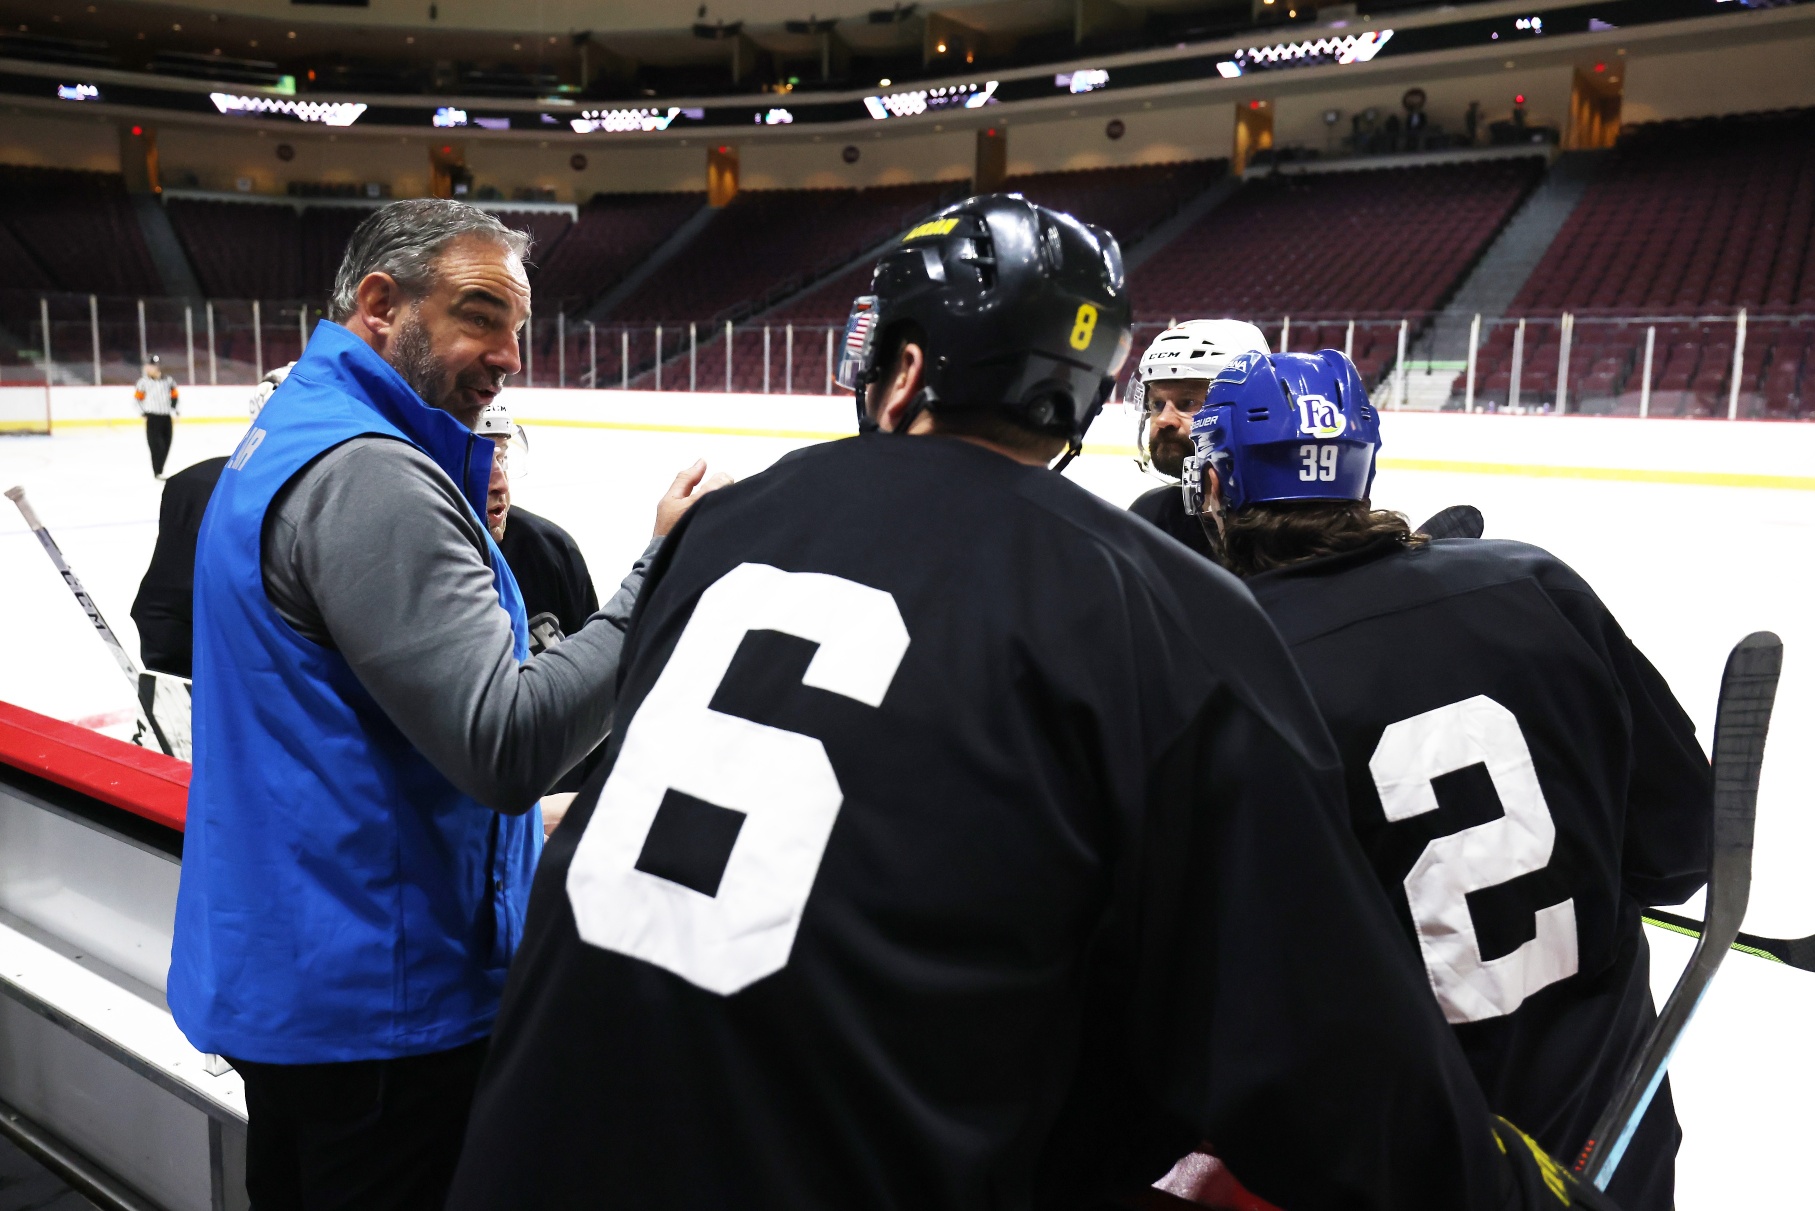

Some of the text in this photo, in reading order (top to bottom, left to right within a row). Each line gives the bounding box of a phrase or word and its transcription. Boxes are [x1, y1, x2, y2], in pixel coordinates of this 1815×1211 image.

[1070, 303, 1097, 350] 8
[1149, 351, 1181, 360] CCM
[1303, 399, 1338, 429] Fa
[1299, 444, 1339, 482] 39
[60, 570, 106, 629] CCM
[566, 562, 911, 997] 6
[1369, 694, 1579, 1024] 2
